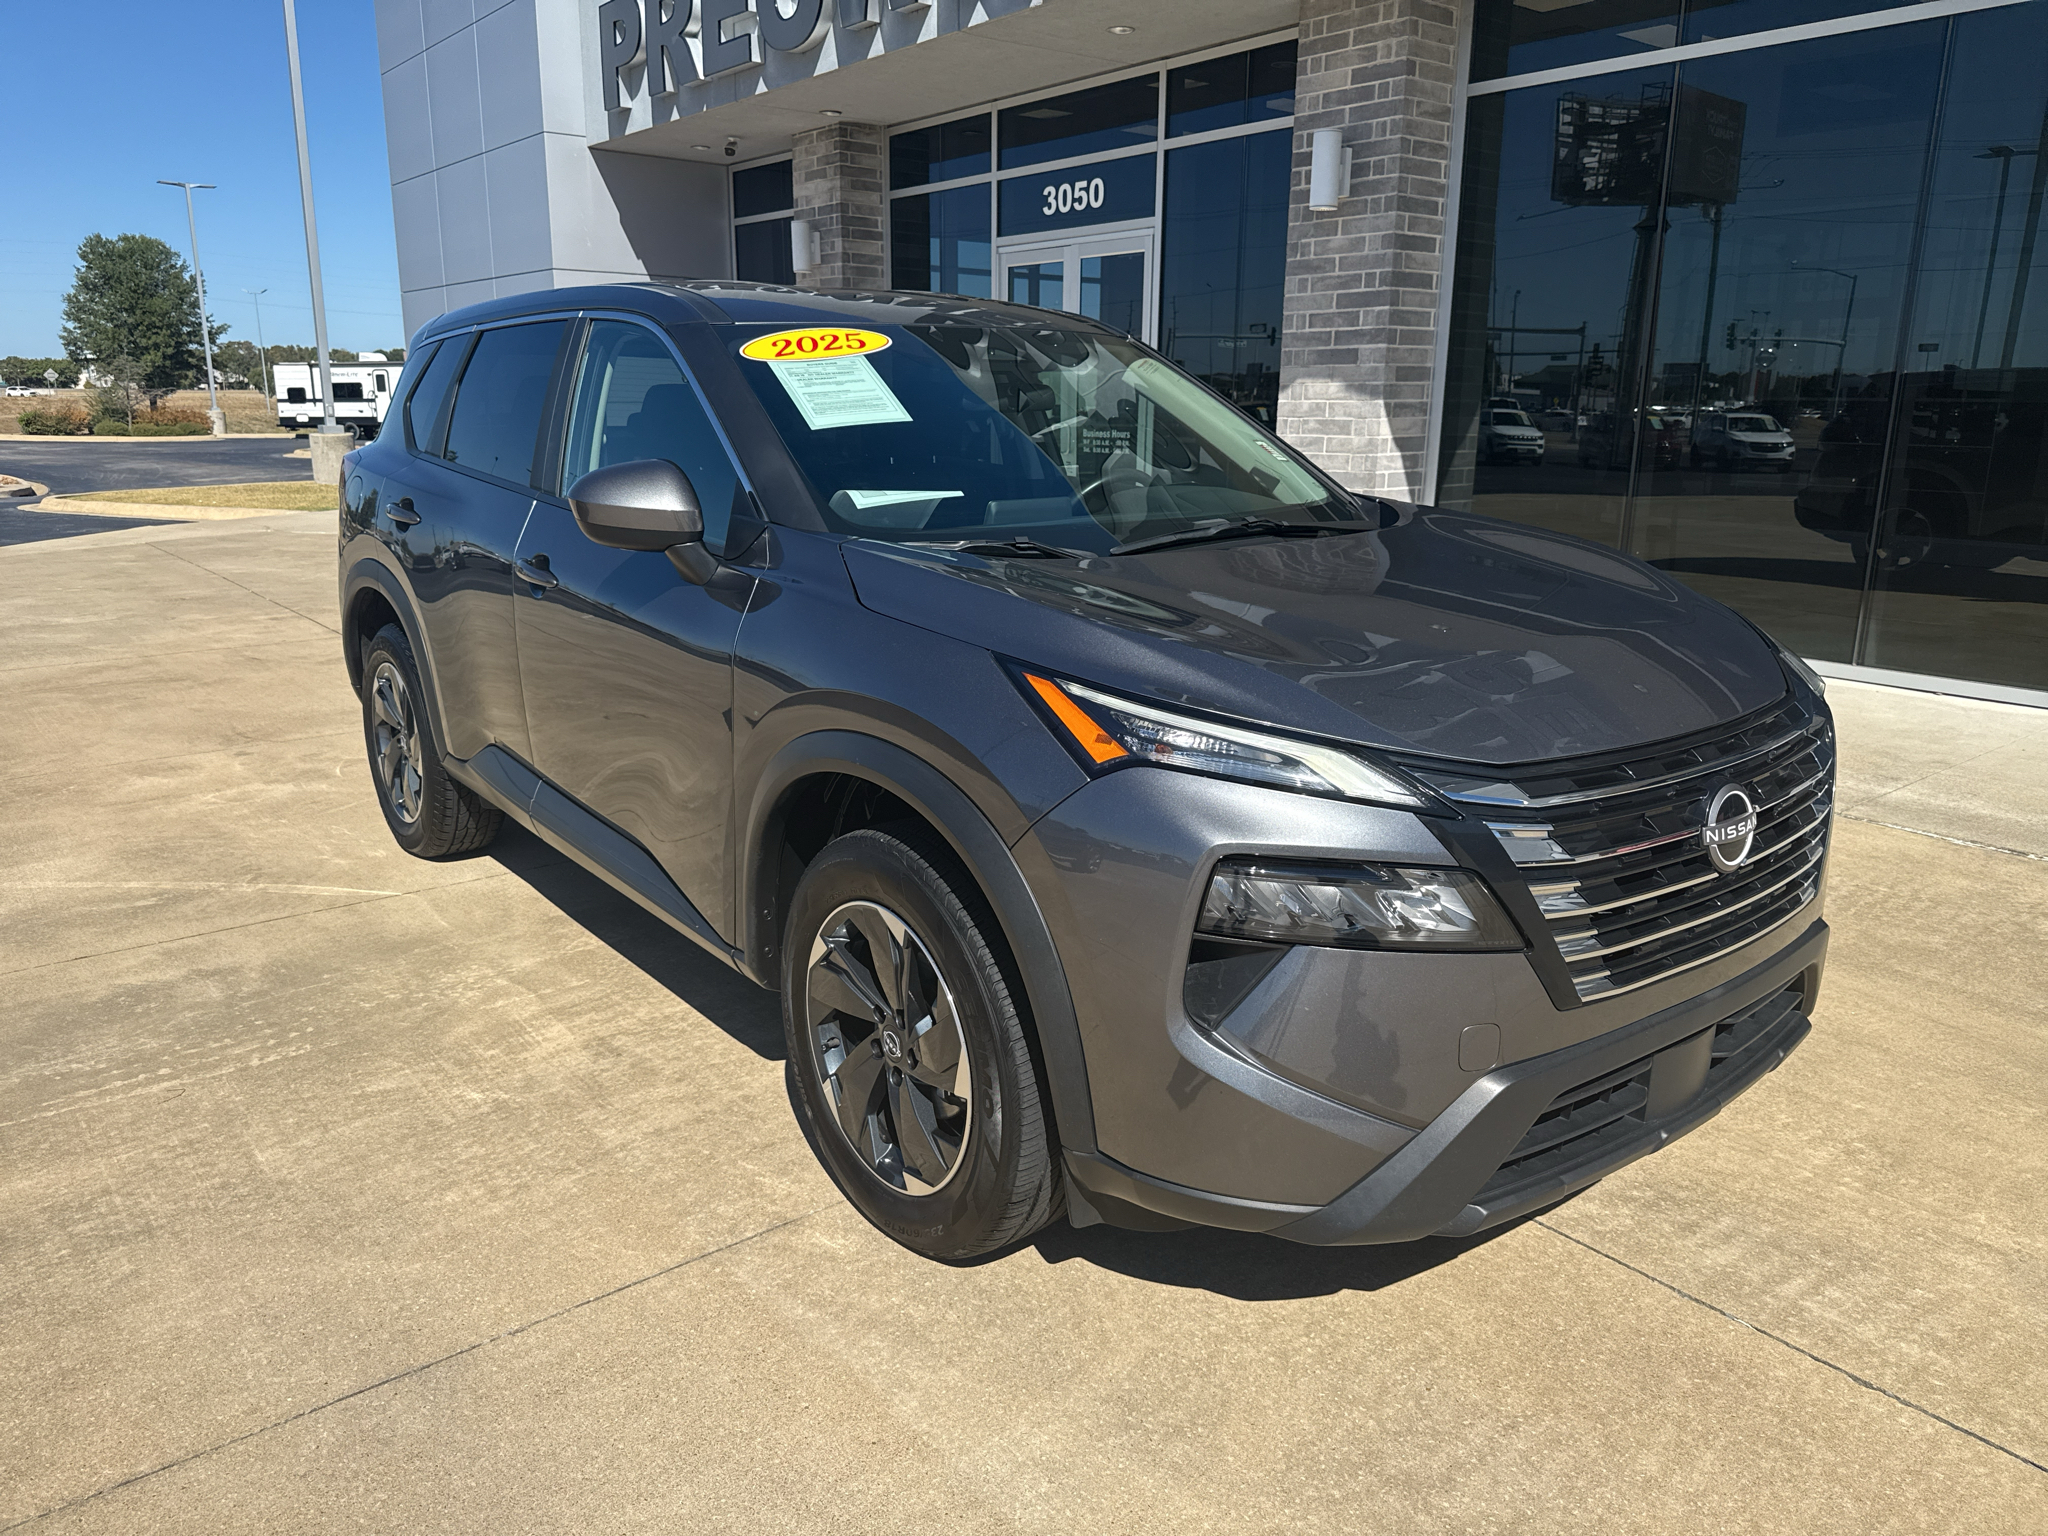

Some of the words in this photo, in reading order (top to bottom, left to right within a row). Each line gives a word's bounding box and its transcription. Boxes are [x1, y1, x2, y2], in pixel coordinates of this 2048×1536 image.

[1042, 177, 1105, 216] 3050
[772, 333, 866, 357] 2025
[1083, 429, 1110, 439] Business
[1112, 429, 1131, 439] Hours
[1706, 816, 1757, 843] NISSAN
